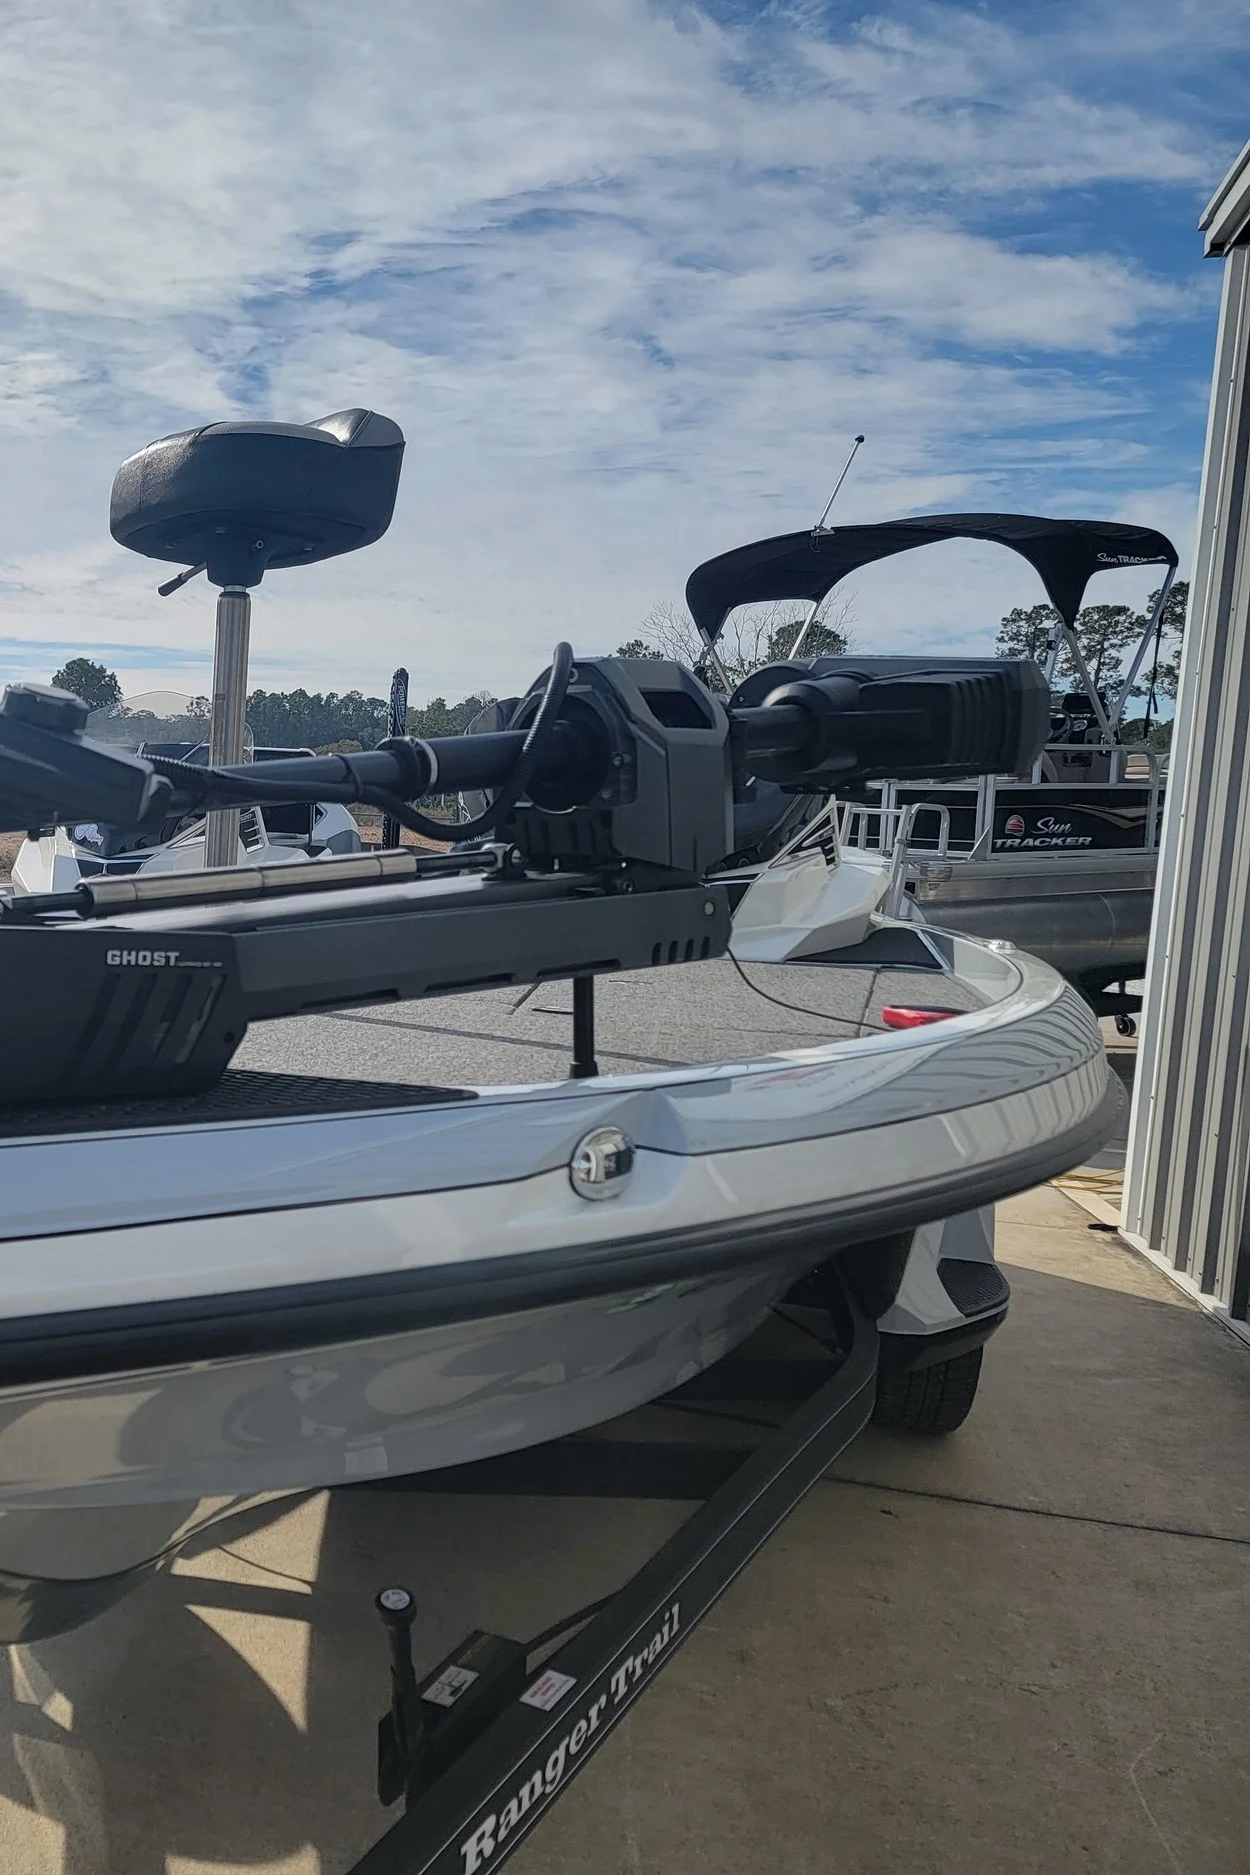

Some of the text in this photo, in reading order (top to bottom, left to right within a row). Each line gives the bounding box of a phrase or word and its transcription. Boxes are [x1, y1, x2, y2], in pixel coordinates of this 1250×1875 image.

[1031, 816, 1072, 834] Sun
[994, 836, 1092, 848] TRACKER
[106, 949, 180, 966] GHOST
[460, 1602, 681, 1875] Ranger Trail
